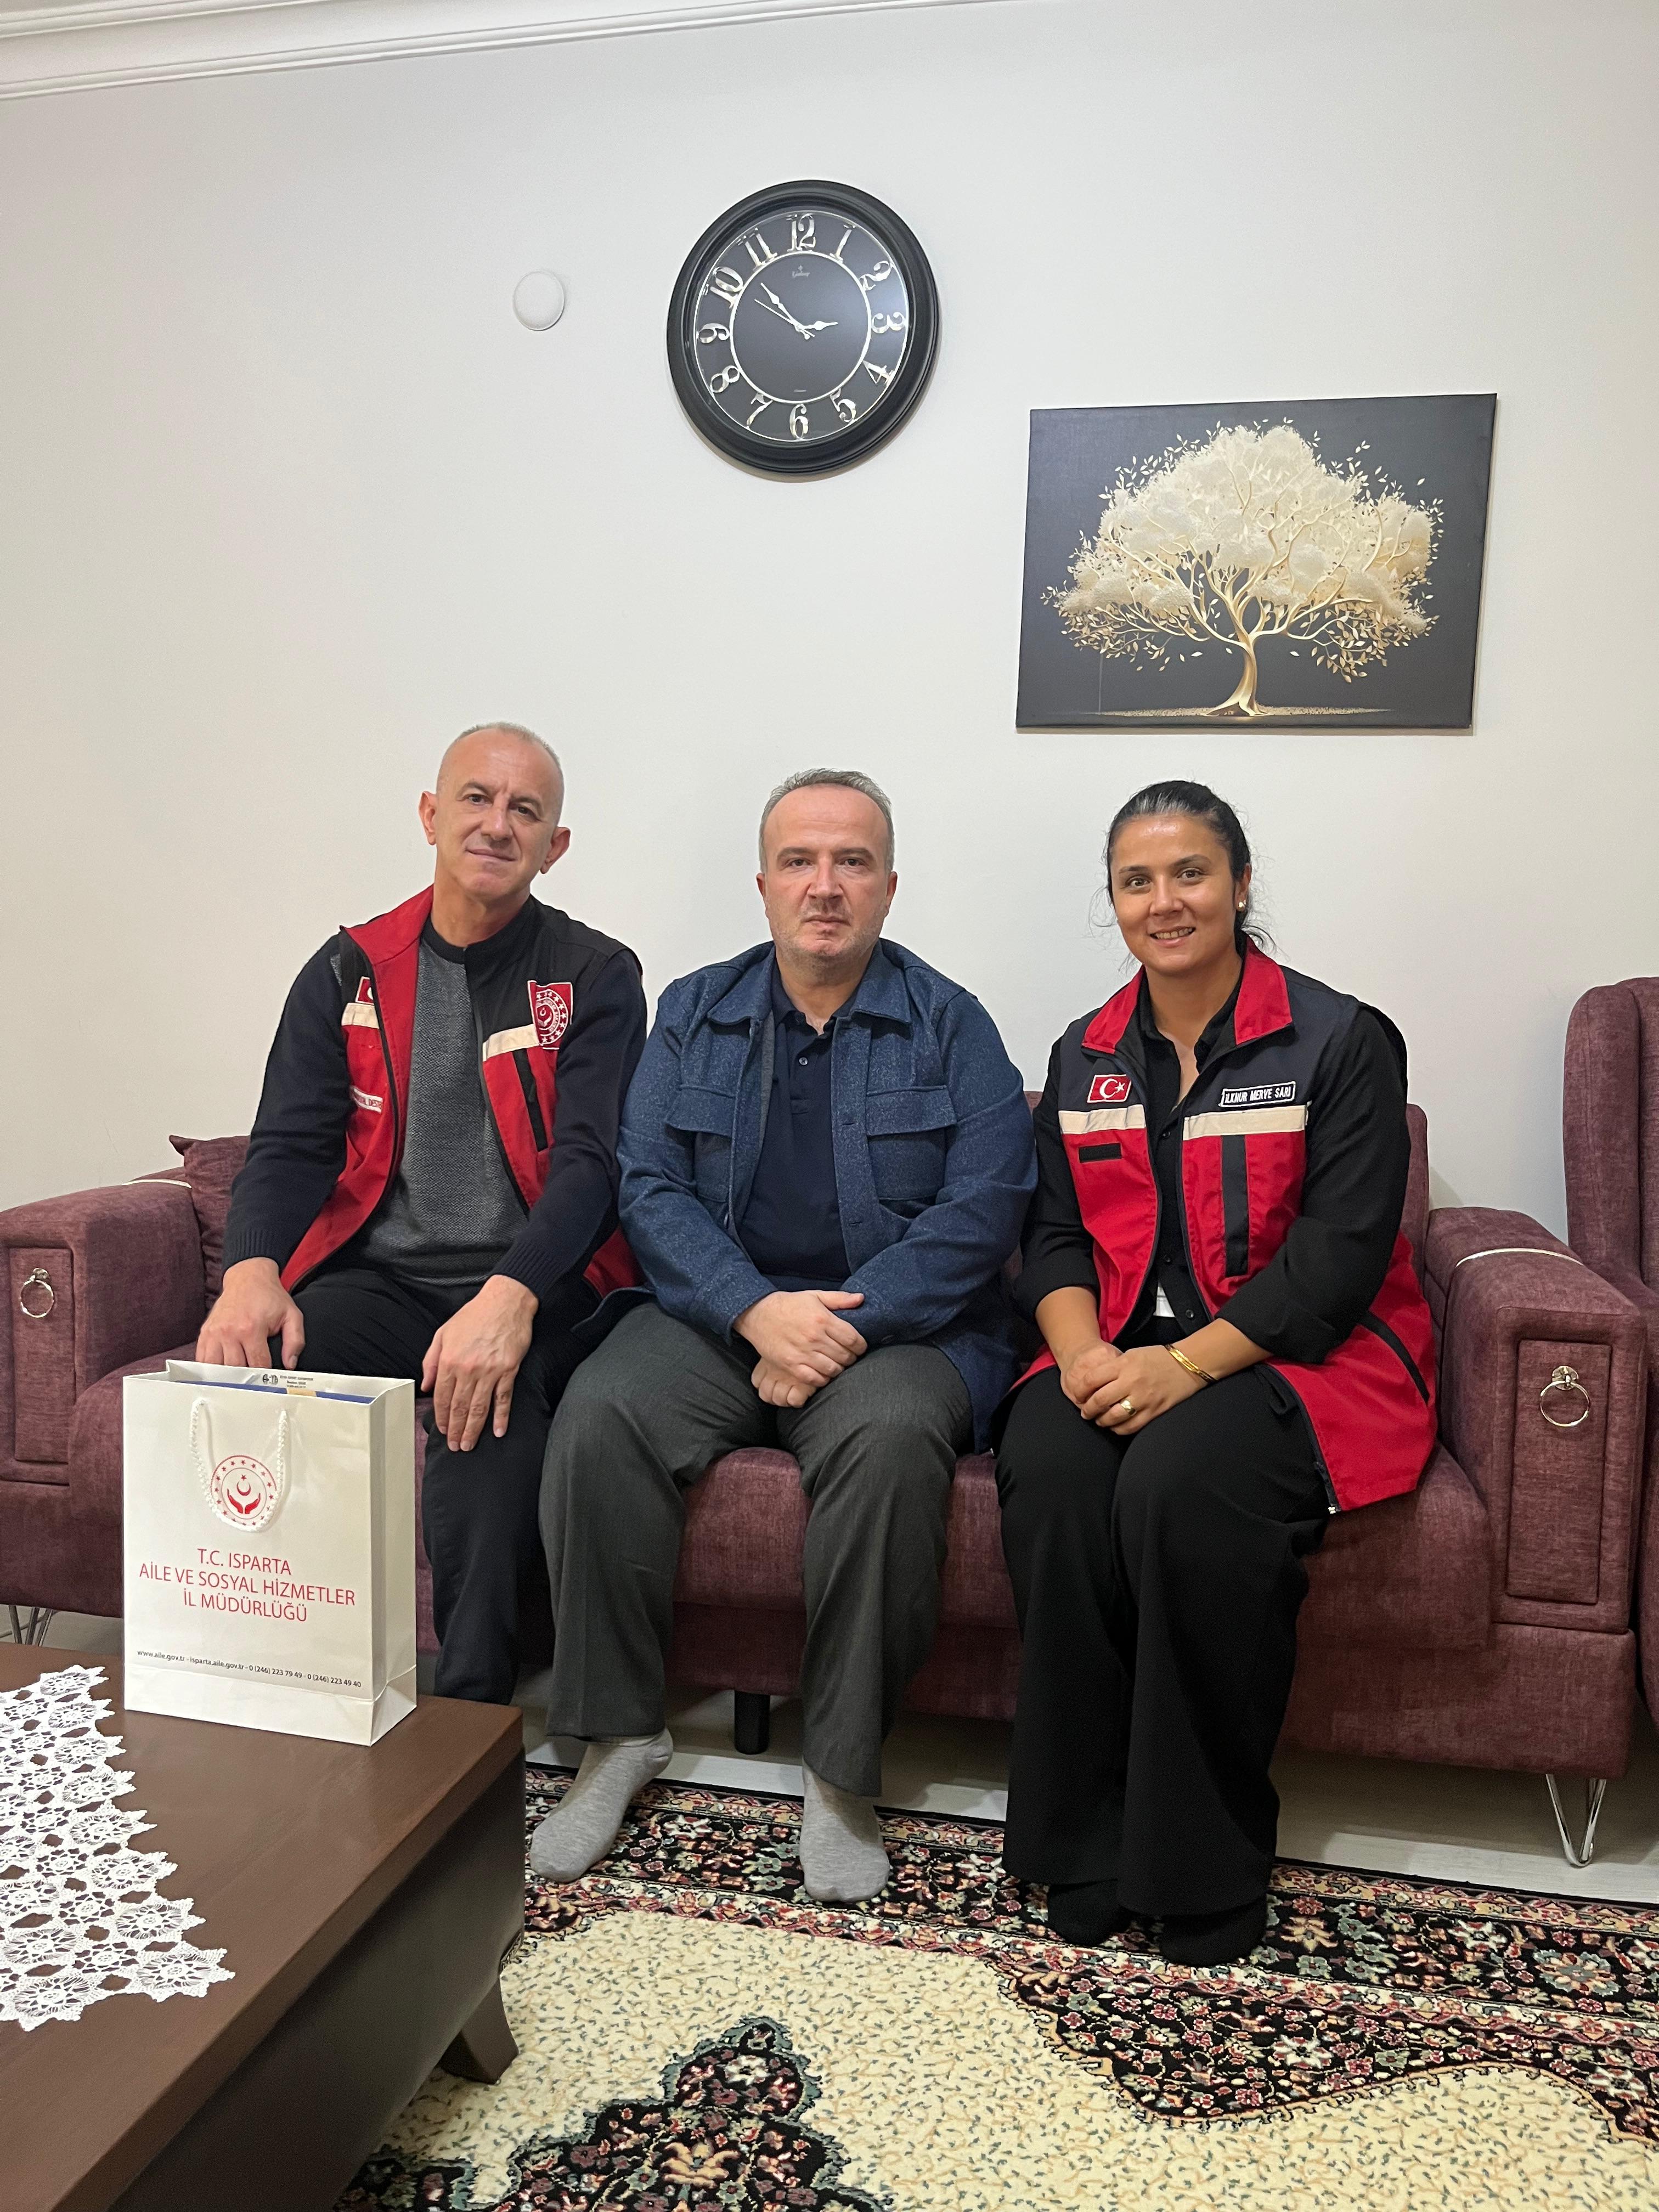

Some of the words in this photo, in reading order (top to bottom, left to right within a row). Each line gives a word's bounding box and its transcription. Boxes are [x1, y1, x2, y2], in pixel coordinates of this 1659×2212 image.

[787, 213, 816, 252] 12
[830, 222, 856, 263] 1
[736, 228, 777, 272] 11
[702, 266, 744, 308] 10
[859, 261, 894, 290] 2
[696, 323, 730, 343] 9
[871, 312, 905, 334] 3
[710, 365, 740, 393] 8
[862, 360, 895, 388] 4
[746, 392, 773, 428] 7
[789, 404, 808, 439] 6
[830, 389, 856, 422] 5
[1250, 1088, 1272, 1101] MERVE
[1274, 1086, 1291, 1098] SARI
[198, 1548, 224, 1566] T.C.
[229, 1553, 291, 1576] ISPARTA
[139, 1561, 171, 1581] AİLE
[175, 1567, 194, 1584] VE
[199, 1571, 258, 1593] SOSYAL
[263, 1578, 355, 1606] HİZMETLER
[184, 1588, 196, 1606] İL
[201, 1593, 307, 1622] MÜDÜRLÜĞÜ
[137, 1650, 184, 1661] www.aile.gov.tr
[190, 1656, 244, 1669] isparta.aile.gov.tr
[255, 1666, 270, 1674] (246)
[313, 1674, 329, 1683] (246)
